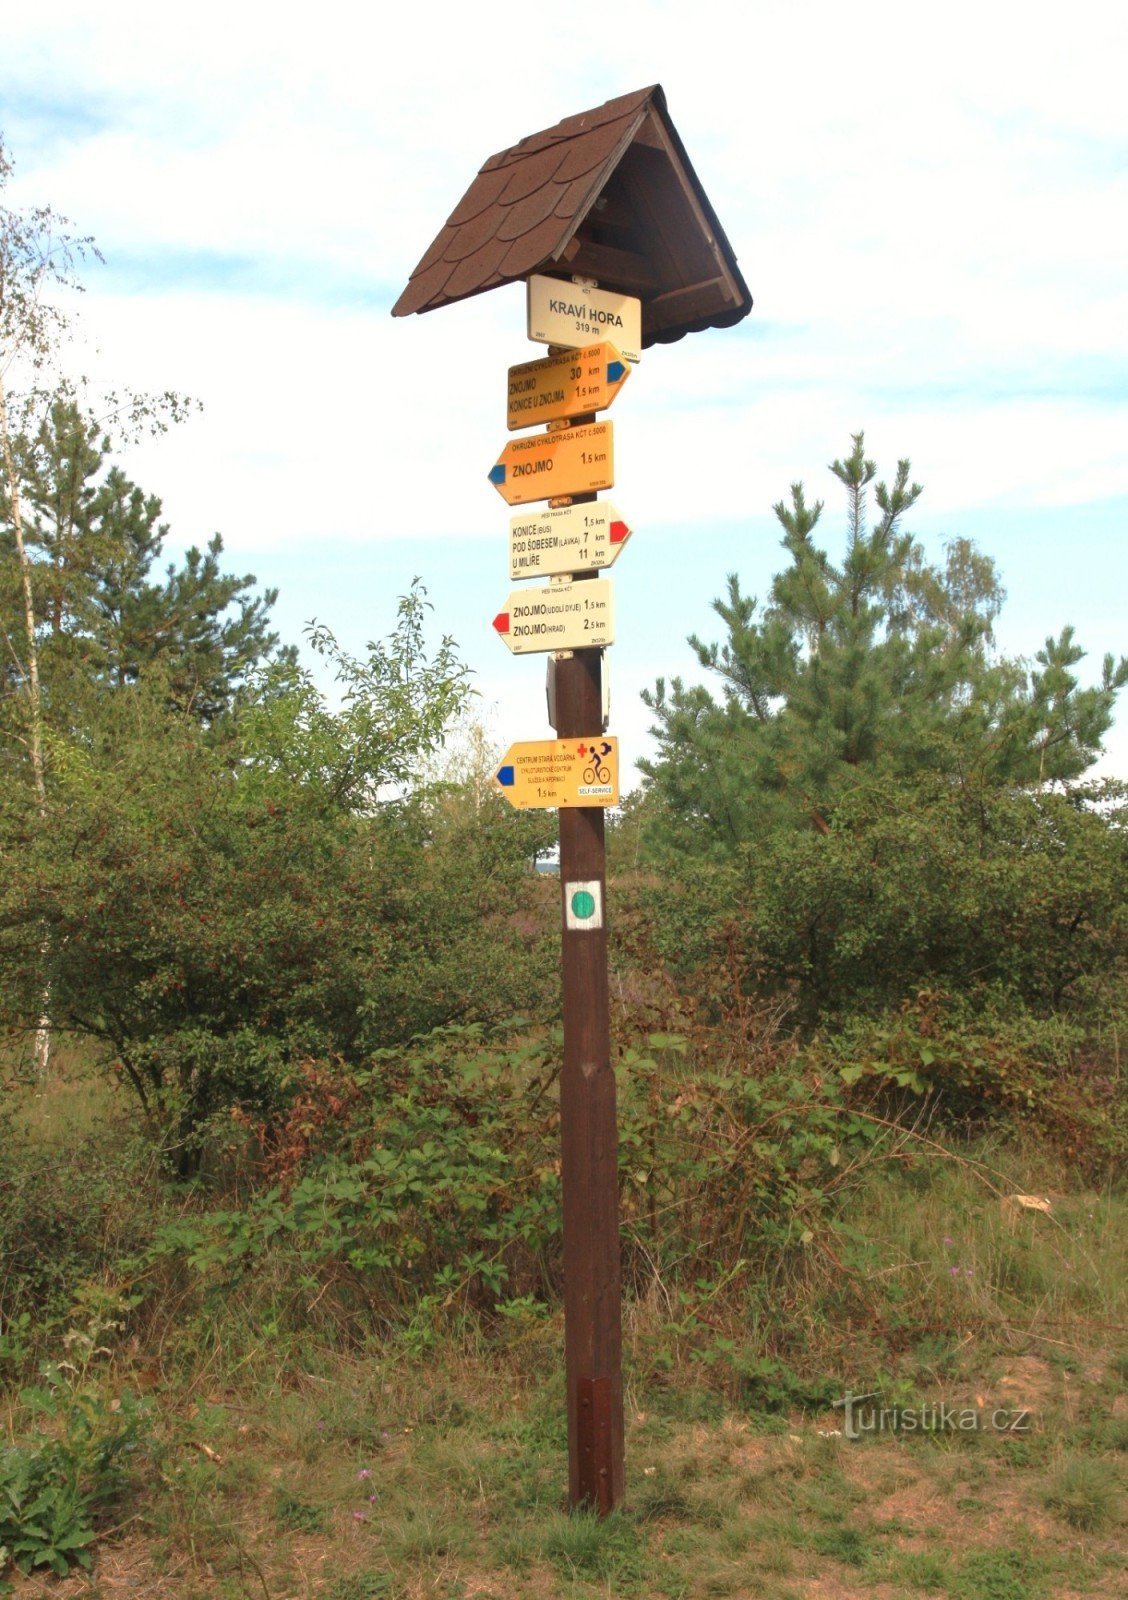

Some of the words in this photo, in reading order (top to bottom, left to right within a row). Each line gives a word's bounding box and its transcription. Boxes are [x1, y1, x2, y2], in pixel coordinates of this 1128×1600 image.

[549, 299, 586, 319] KRAVÍ
[589, 308, 624, 328] HORA
[575, 321, 590, 333] 319
[591, 326, 600, 335] m
[509, 378, 537, 395] ZNOJMO
[570, 367, 582, 380] 30
[588, 367, 600, 377] km
[509, 395, 533, 413] KONICE
[533, 395, 539, 405] U
[539, 389, 565, 406] ZNOJMA
[588, 385, 600, 394] km
[537, 432, 575, 447] CYKLOTRASA
[575, 429, 587, 439] KČT
[512, 458, 554, 478] ZNOJMO
[594, 453, 607, 462] km
[512, 524, 537, 538] KONICE
[512, 541, 527, 553] POD
[527, 536, 559, 551] ŠOBESEM
[583, 532, 589, 543] 7
[512, 559, 518, 569] U
[518, 553, 540, 568] MILÍŘE
[579, 548, 588, 560] 11
[594, 550, 605, 558] km
[516, 755, 538, 764] CENTRUM
[579, 787, 612, 795] SELF-SERVICE
